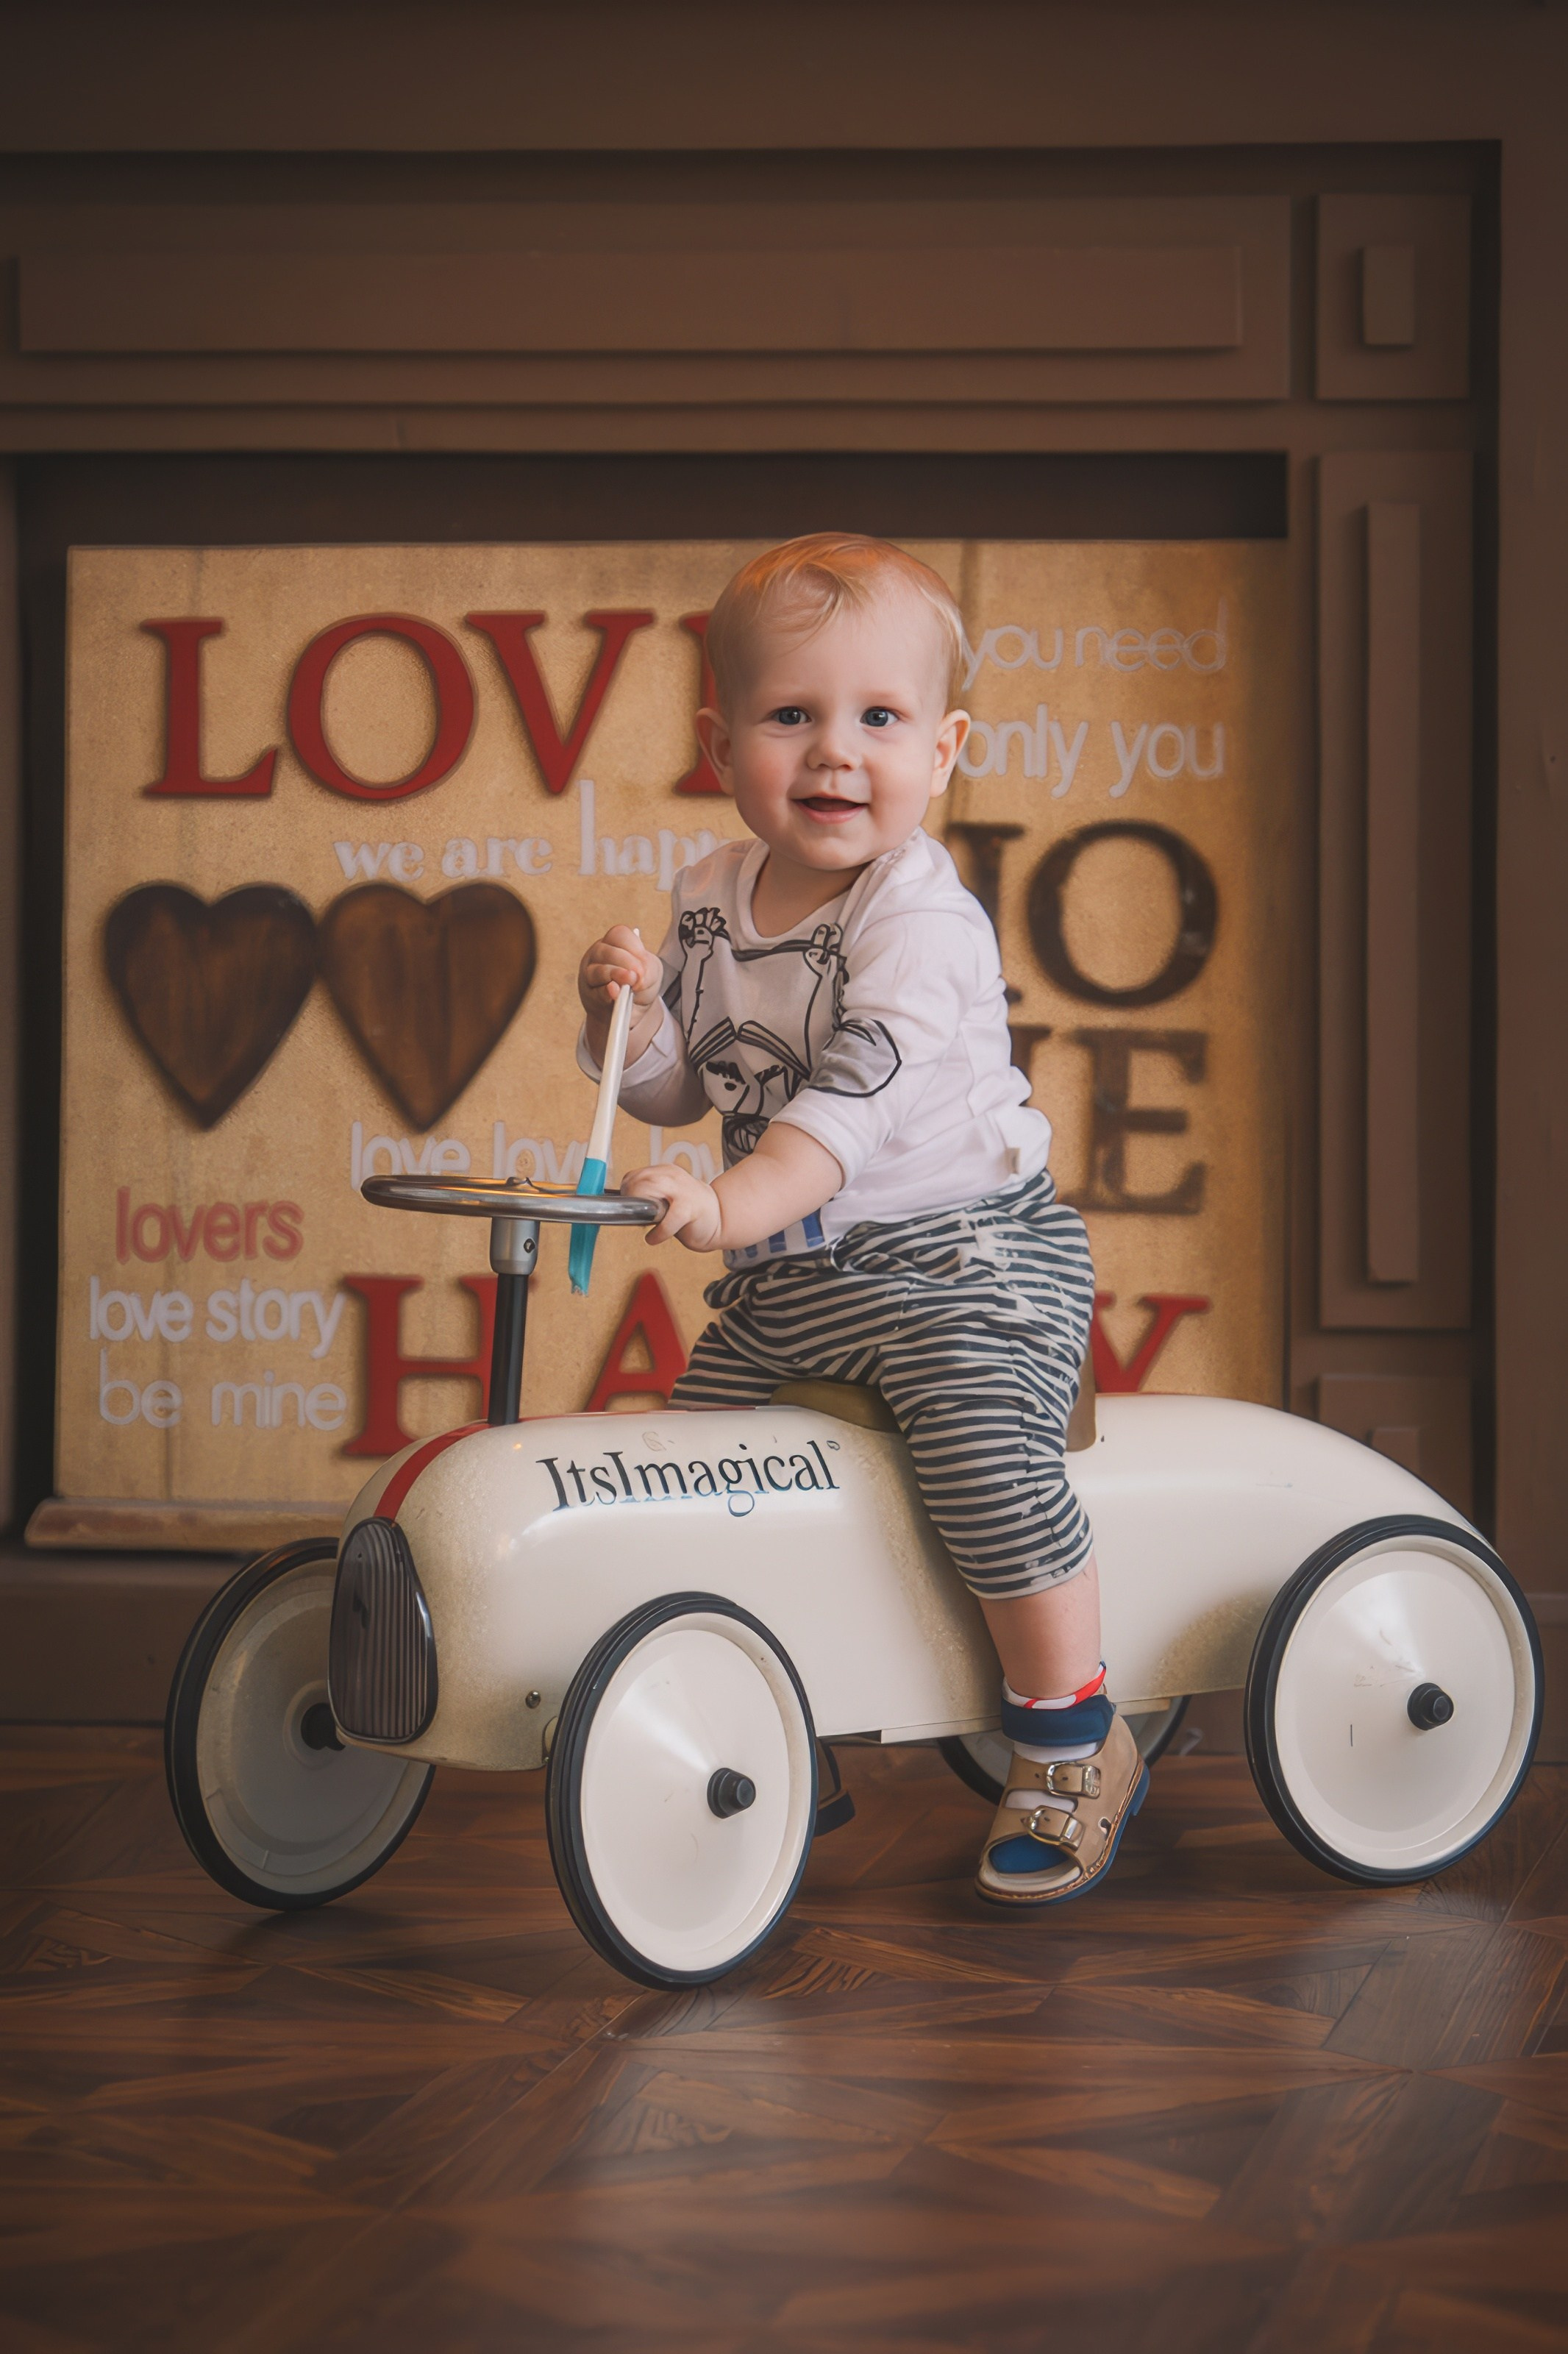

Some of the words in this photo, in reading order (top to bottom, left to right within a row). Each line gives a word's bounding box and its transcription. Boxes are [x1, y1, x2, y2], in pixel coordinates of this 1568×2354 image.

[961, 624, 1063, 691] you
[1075, 596, 1229, 672] need
[957, 703, 1089, 798] only
[1109, 720, 1226, 798] you
[333, 839, 425, 883] we
[442, 835, 554, 881] are
[578, 779, 735, 892] hap
[351, 1120, 471, 1191] love
[493, 1120, 613, 1182] lov
[115, 1186, 304, 1265] lovers
[90, 1275, 194, 1343] love
[205, 1277, 346, 1359] story
[99, 1347, 183, 1429] be
[212, 1369, 347, 1431] mine
[535, 1440, 841, 1518] ItsImagical
